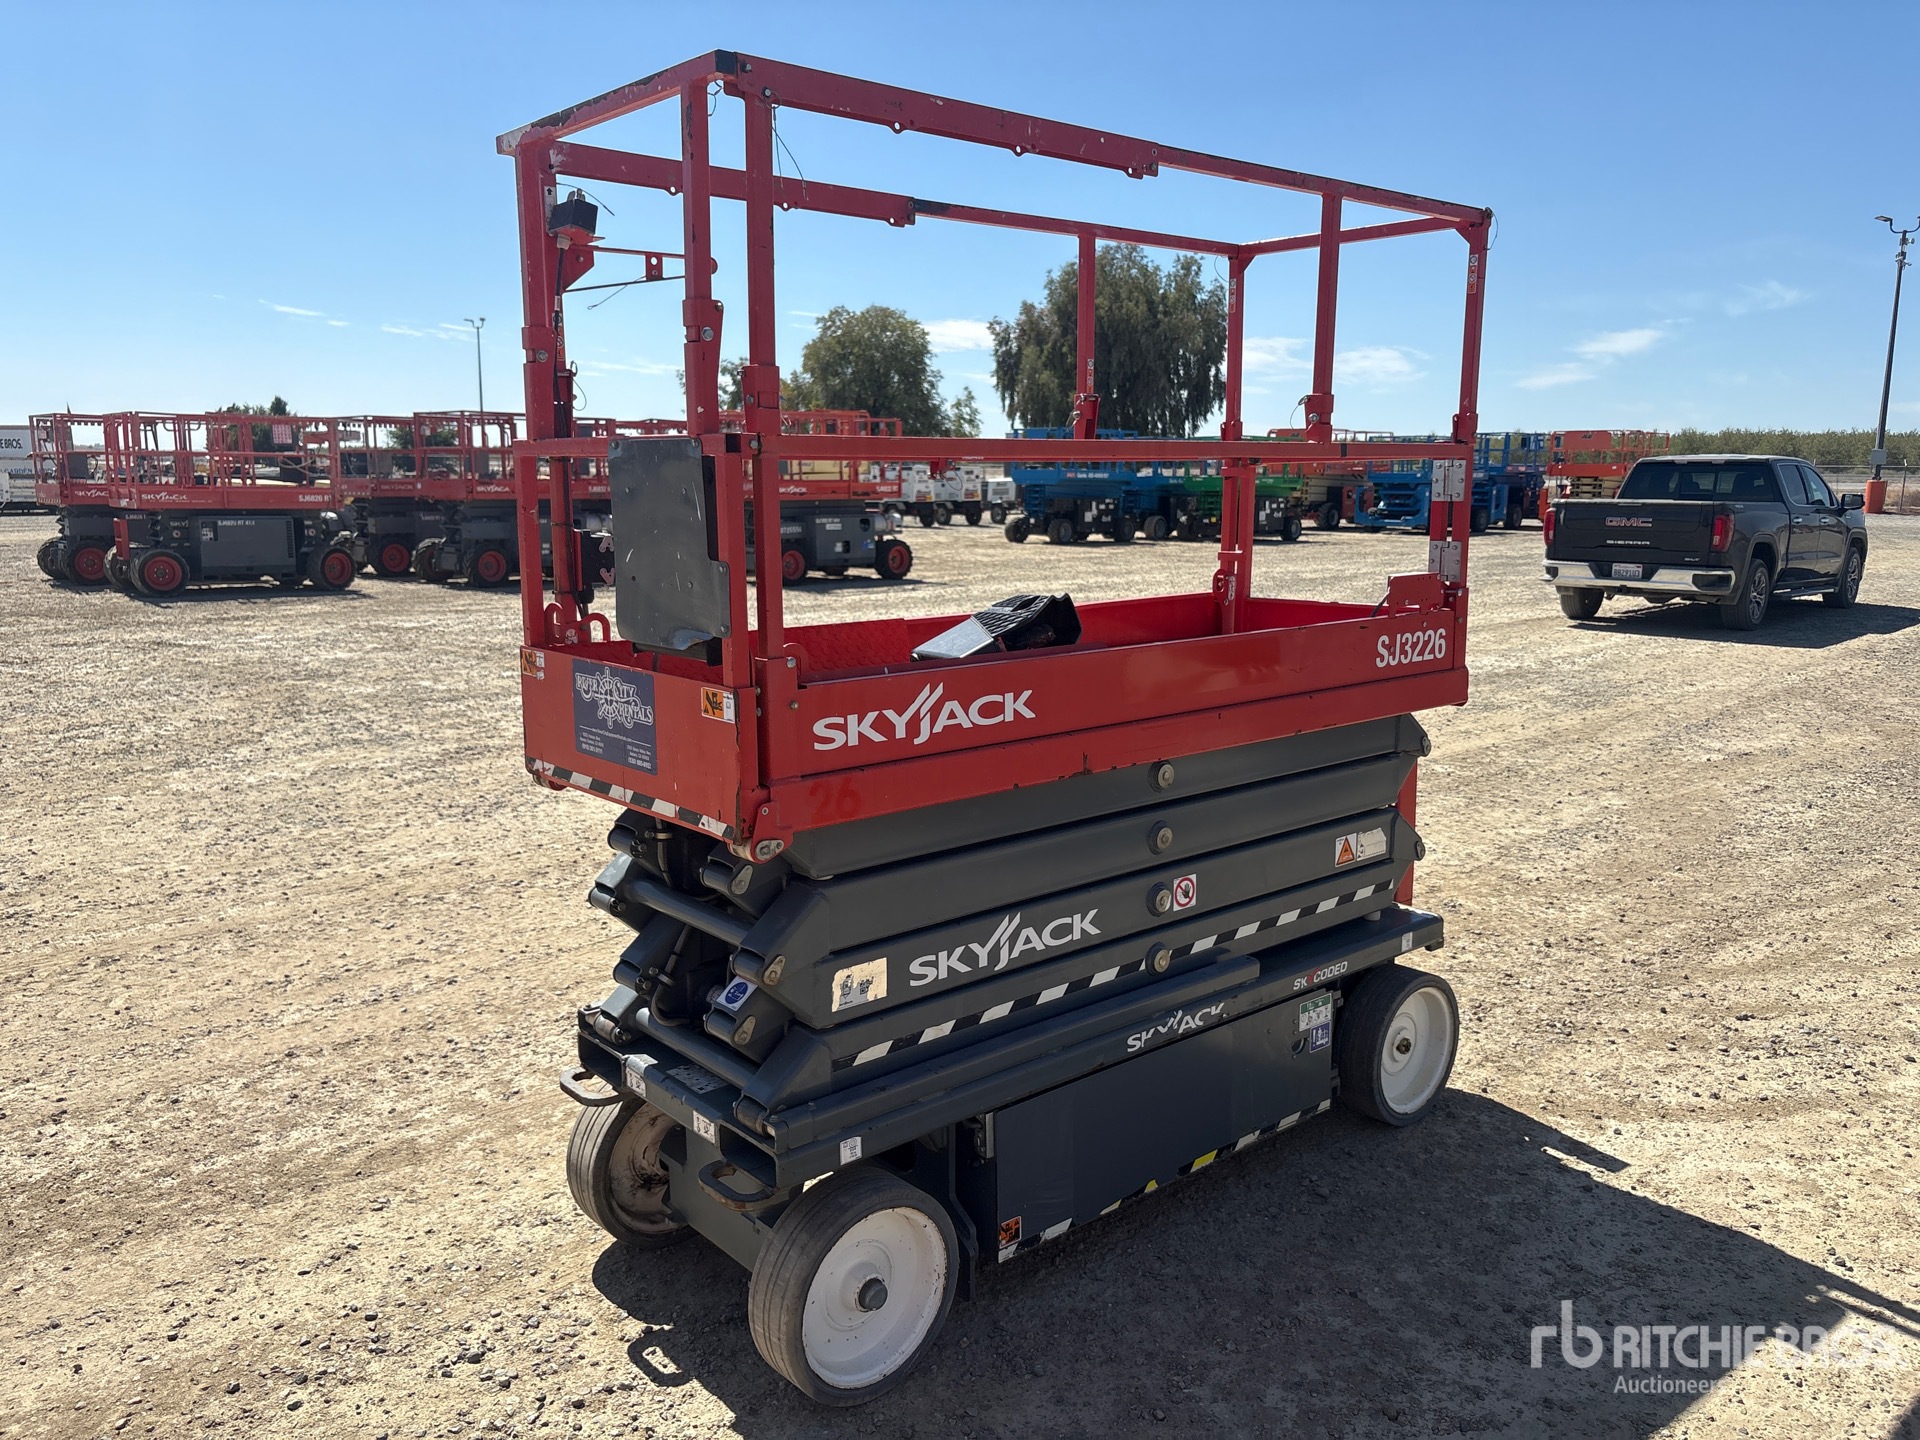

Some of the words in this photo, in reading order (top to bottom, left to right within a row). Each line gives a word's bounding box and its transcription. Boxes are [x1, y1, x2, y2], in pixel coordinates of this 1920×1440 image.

[74, 489, 109, 498] SKYJAC
[141, 491, 188, 501] SKYJACK
[1605, 516, 1653, 528] GMC
[1375, 628, 1446, 668] SJ3226
[812, 681, 1036, 751] SKYJACK
[908, 908, 1101, 986] SKYJACK
